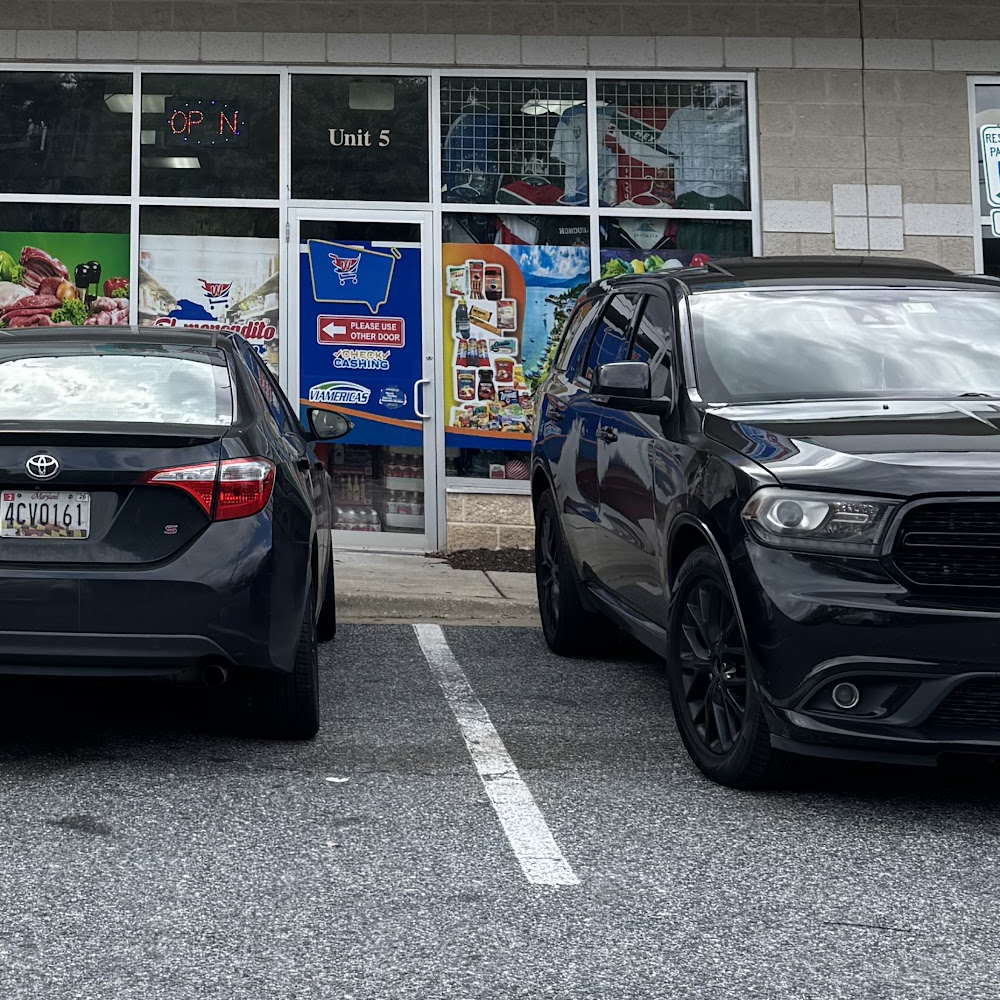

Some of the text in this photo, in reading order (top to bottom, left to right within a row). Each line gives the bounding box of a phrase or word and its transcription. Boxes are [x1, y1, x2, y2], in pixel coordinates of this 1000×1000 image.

[170, 110, 238, 134] OPN
[328, 128, 390, 147] Unit 5
[350, 321, 397, 331] PLEASE USE
[350, 332, 400, 341] OTHER DOOR
[341, 349, 384, 360] CHECK
[333, 358, 389, 370] CASHING
[309, 389, 369, 403] VIAMERICAS
[4, 502, 82, 527] 4CV0161
[163, 524, 179, 535] S
